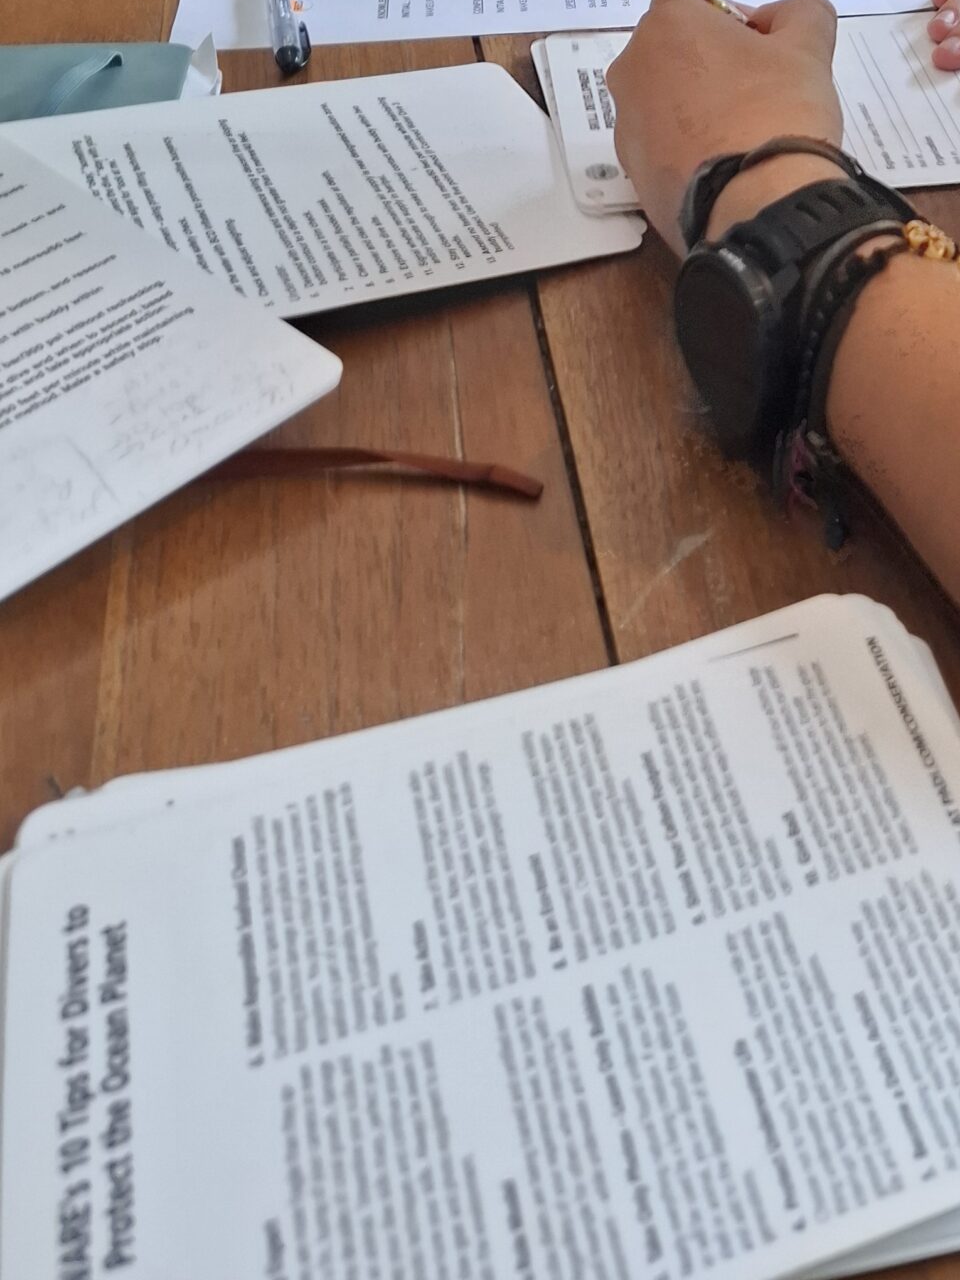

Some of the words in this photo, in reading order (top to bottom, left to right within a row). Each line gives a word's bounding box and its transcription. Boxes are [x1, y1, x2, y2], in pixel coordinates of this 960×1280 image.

[64, 905, 89, 933] to
[60, 937, 89, 1020] Divers
[99, 922, 127, 1004] Planet
[58, 1027, 89, 1068] for
[101, 1009, 130, 1093] Ocean
[59, 1073, 95, 1131] Tips
[102, 1101, 131, 1148] the
[59, 1138, 90, 1171] 10
[104, 1156, 133, 1267] Protect
